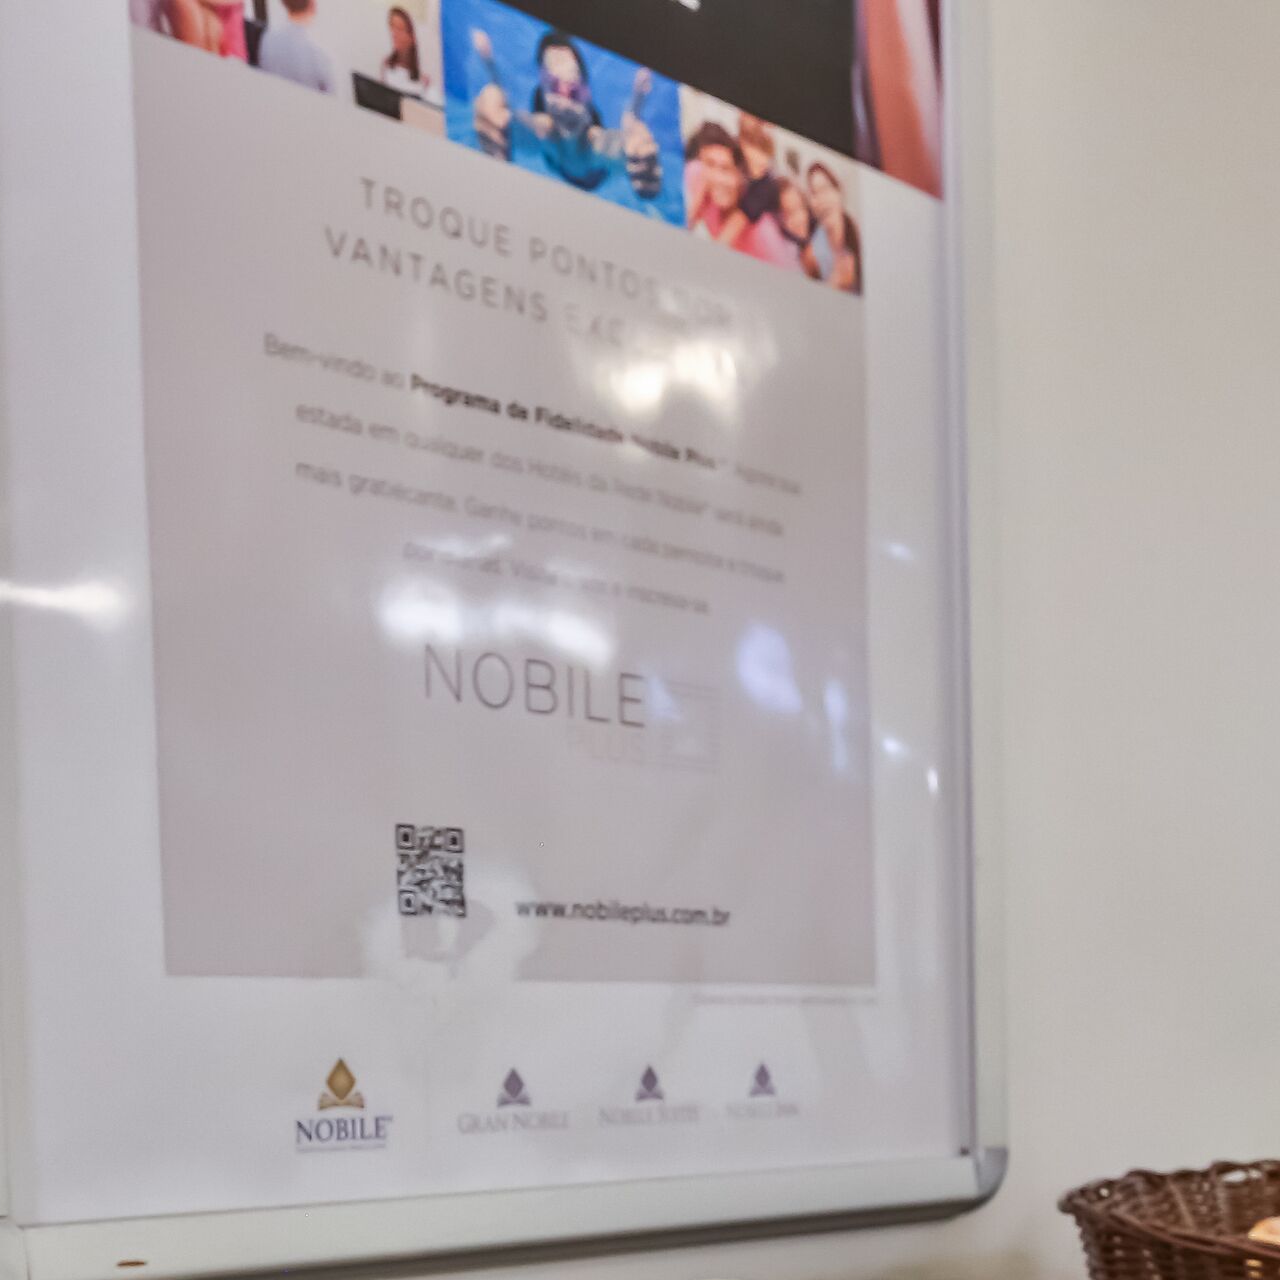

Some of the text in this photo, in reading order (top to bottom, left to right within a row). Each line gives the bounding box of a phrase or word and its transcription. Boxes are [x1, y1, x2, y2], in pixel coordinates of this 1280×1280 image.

[323, 224, 549, 324] VANTAGENS
[359, 175, 513, 258] TROQUE
[528, 236, 660, 306] PONTOS
[410, 371, 502, 416] Programa
[534, 406, 625, 445] Fidelidade
[423, 643, 648, 731] NOBILE
[514, 897, 732, 928] www.nobileplus.com.br
[293, 1114, 389, 1146] NOBILE
